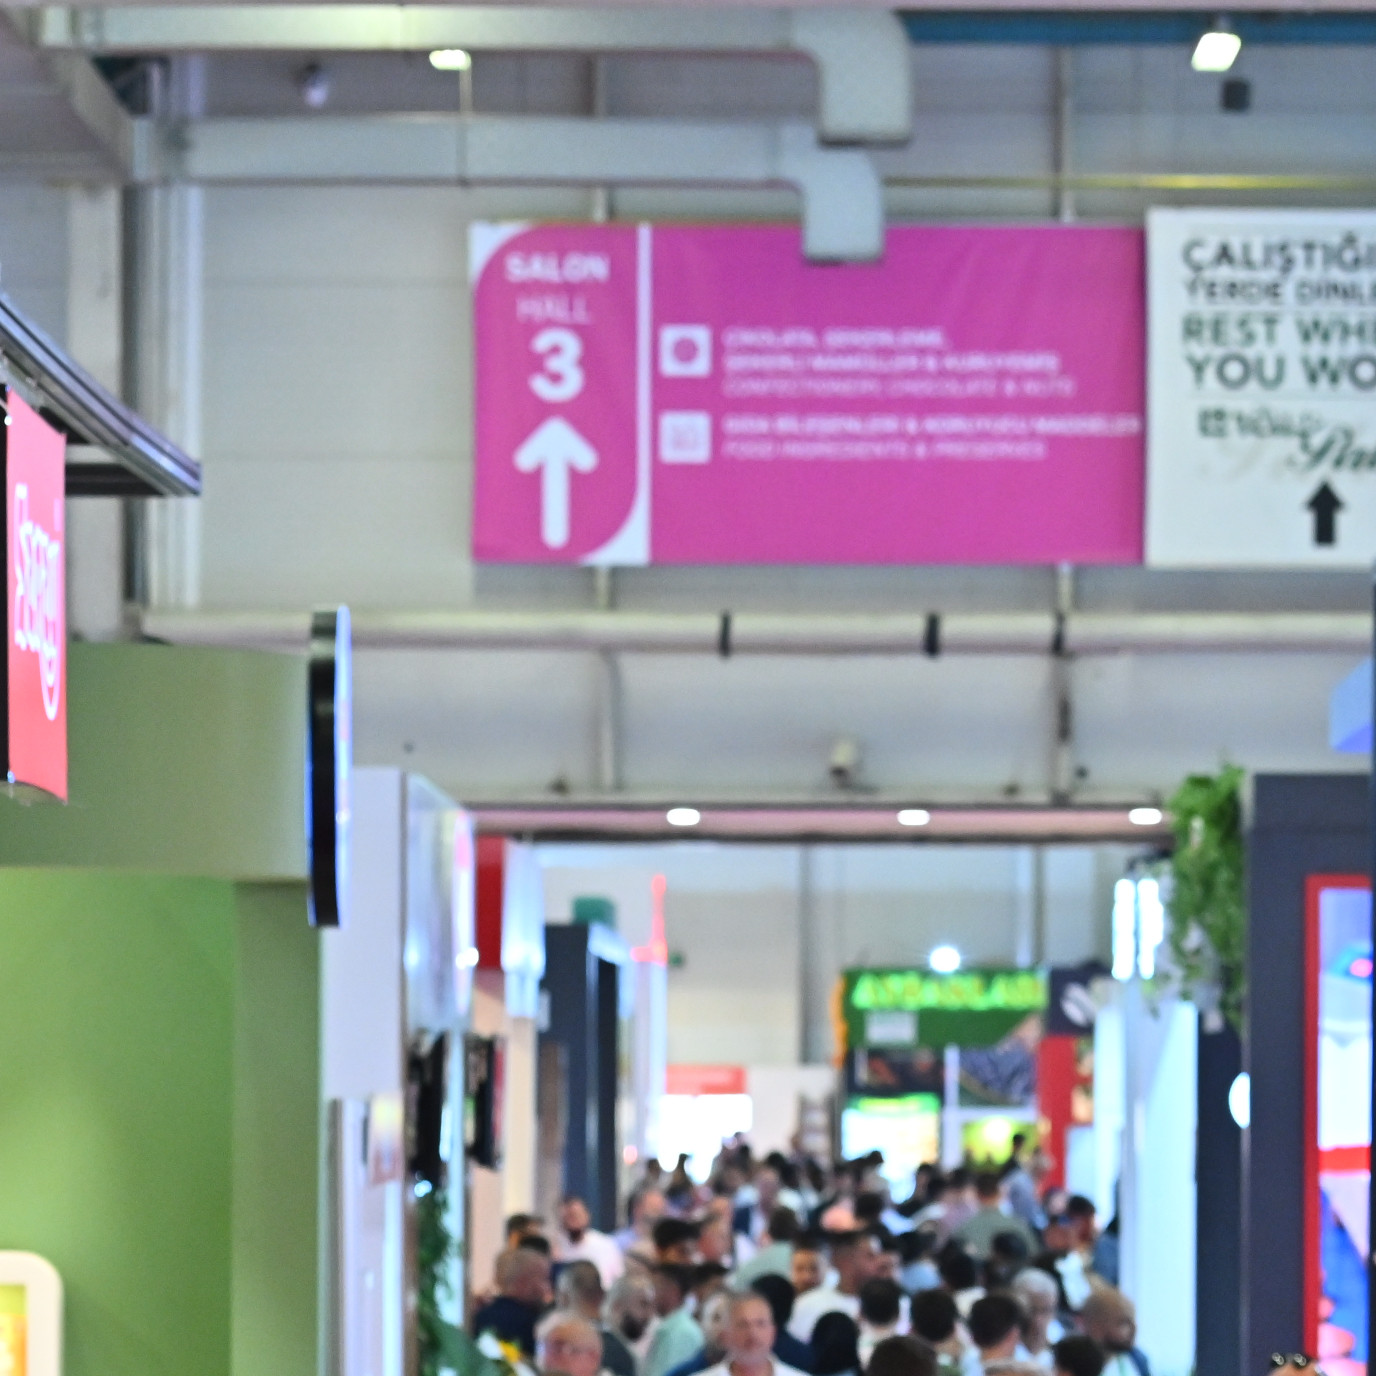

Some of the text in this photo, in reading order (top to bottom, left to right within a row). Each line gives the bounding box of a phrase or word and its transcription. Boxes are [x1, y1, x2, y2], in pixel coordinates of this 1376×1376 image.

[505, 252, 610, 284] SALON
[517, 298, 593, 325] HALL
[1182, 311, 1280, 348] REST
[527, 327, 585, 404] 3
[1185, 353, 1285, 391] YOU
